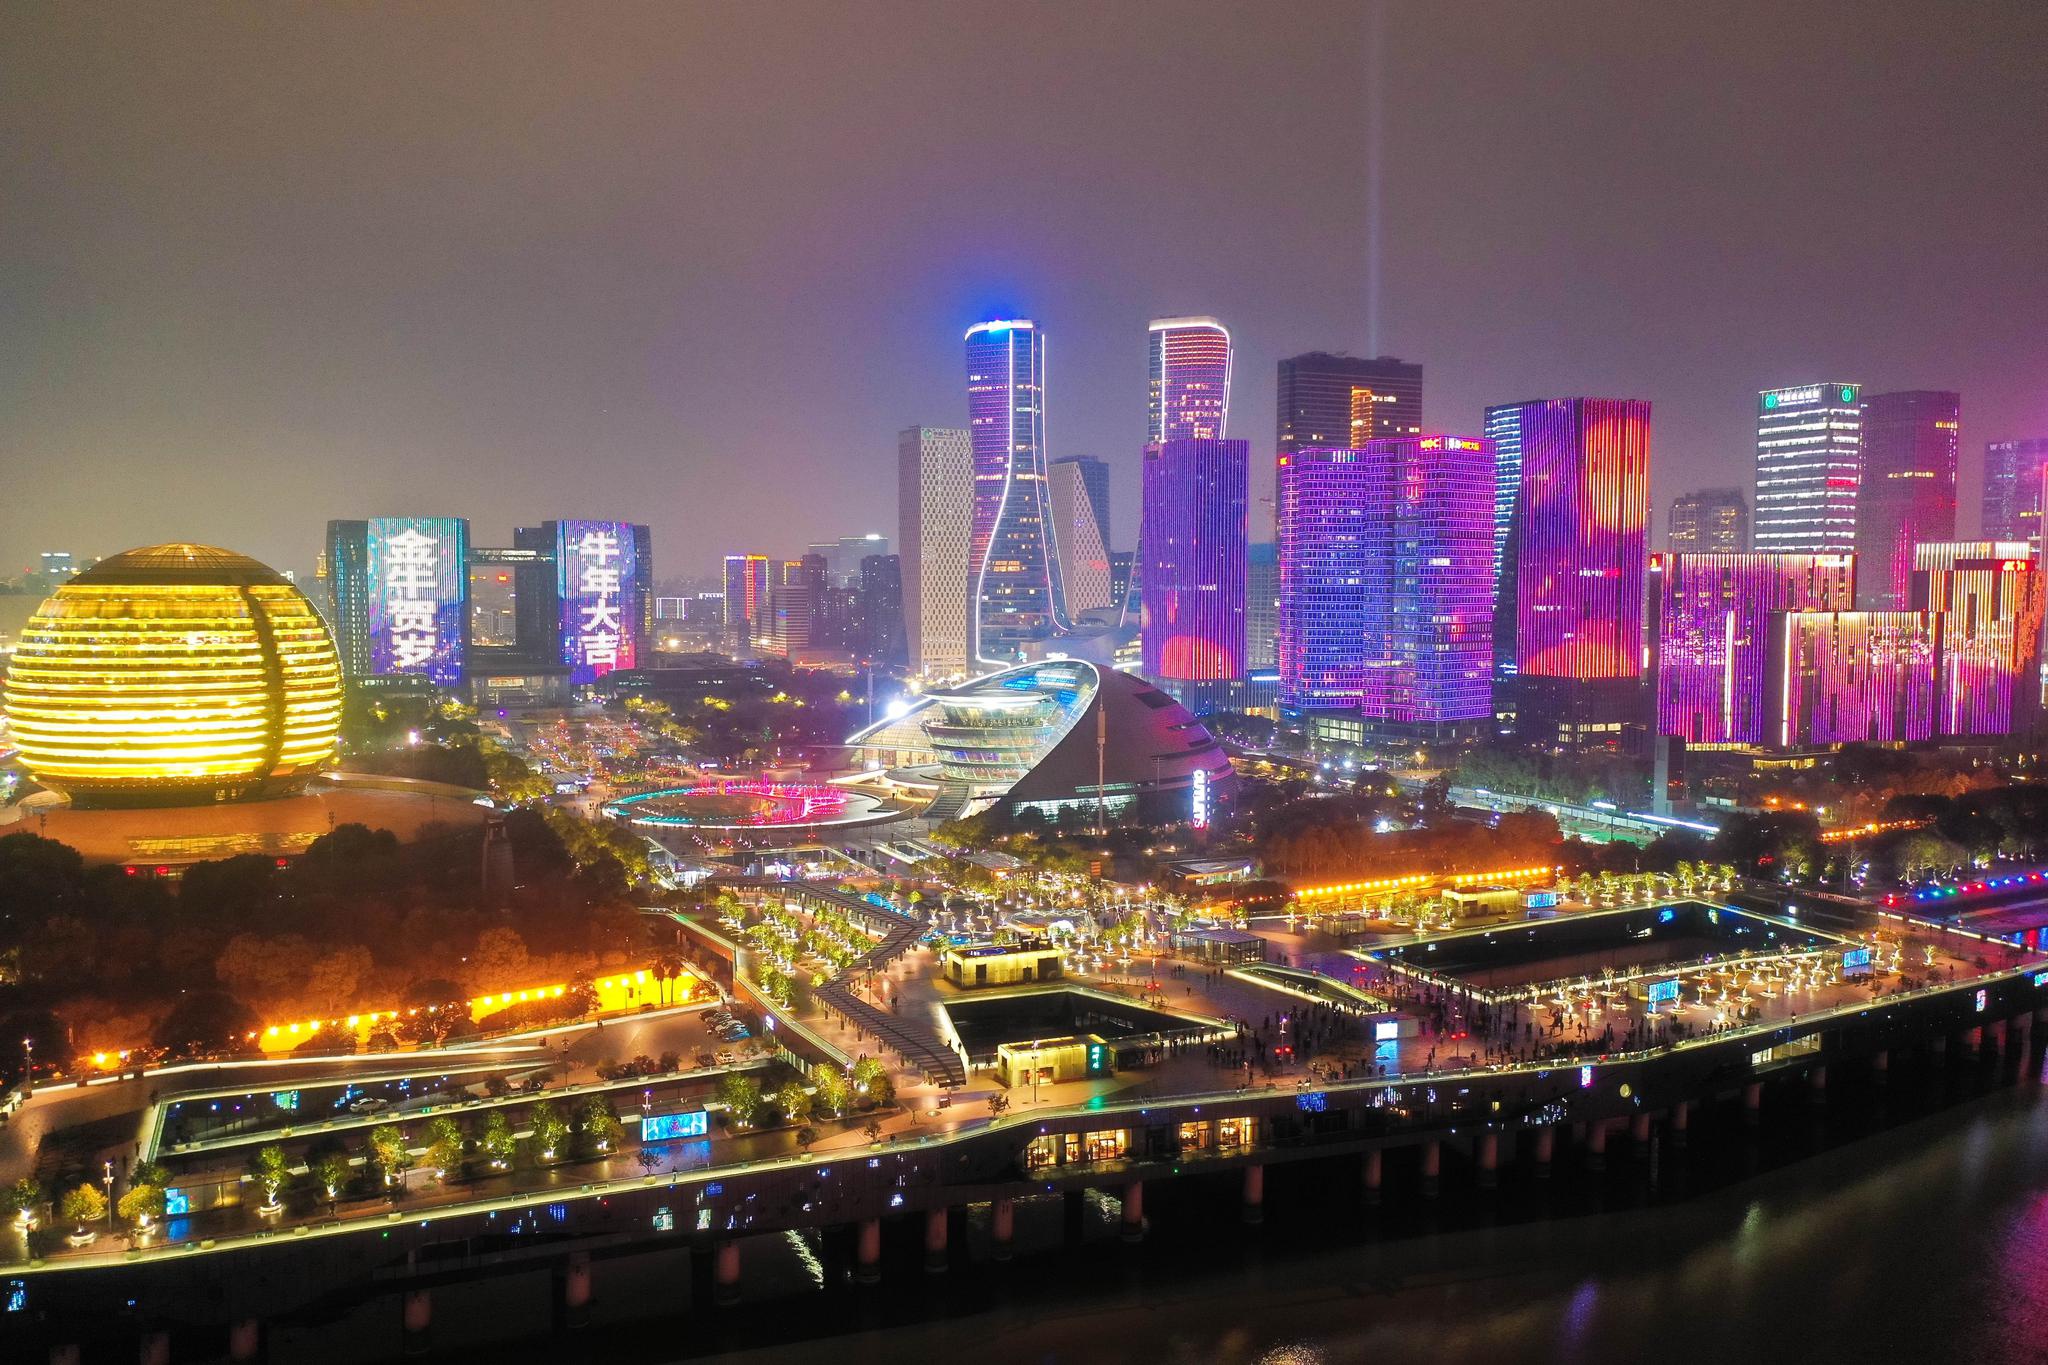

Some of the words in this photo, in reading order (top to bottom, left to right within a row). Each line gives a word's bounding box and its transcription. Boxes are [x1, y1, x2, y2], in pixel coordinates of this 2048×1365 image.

[386, 528, 438, 667] 金牛贺岁
[579, 531, 620, 668] 牛年大吉
